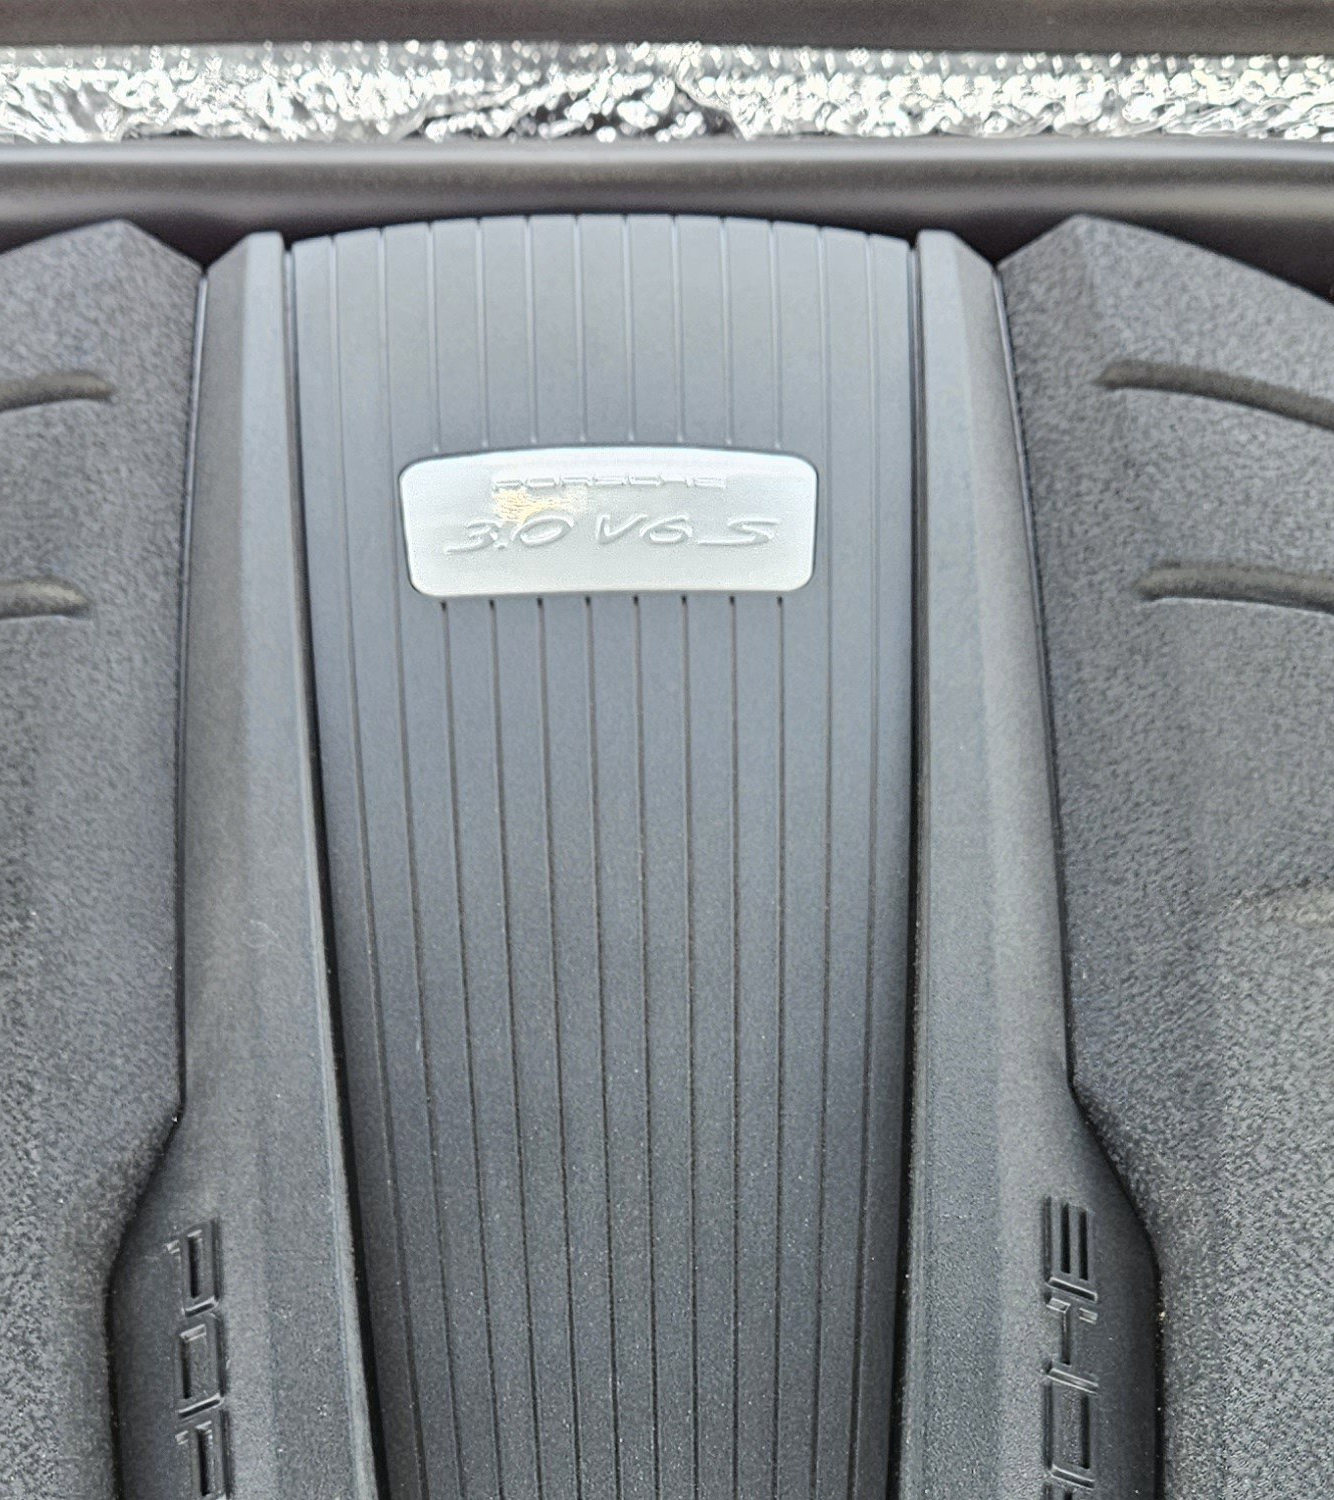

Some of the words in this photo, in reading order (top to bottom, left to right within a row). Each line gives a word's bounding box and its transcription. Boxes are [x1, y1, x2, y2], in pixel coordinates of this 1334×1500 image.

[443, 514, 574, 555] 3.0
[595, 514, 693, 545] V6
[697, 517, 780, 547] S
